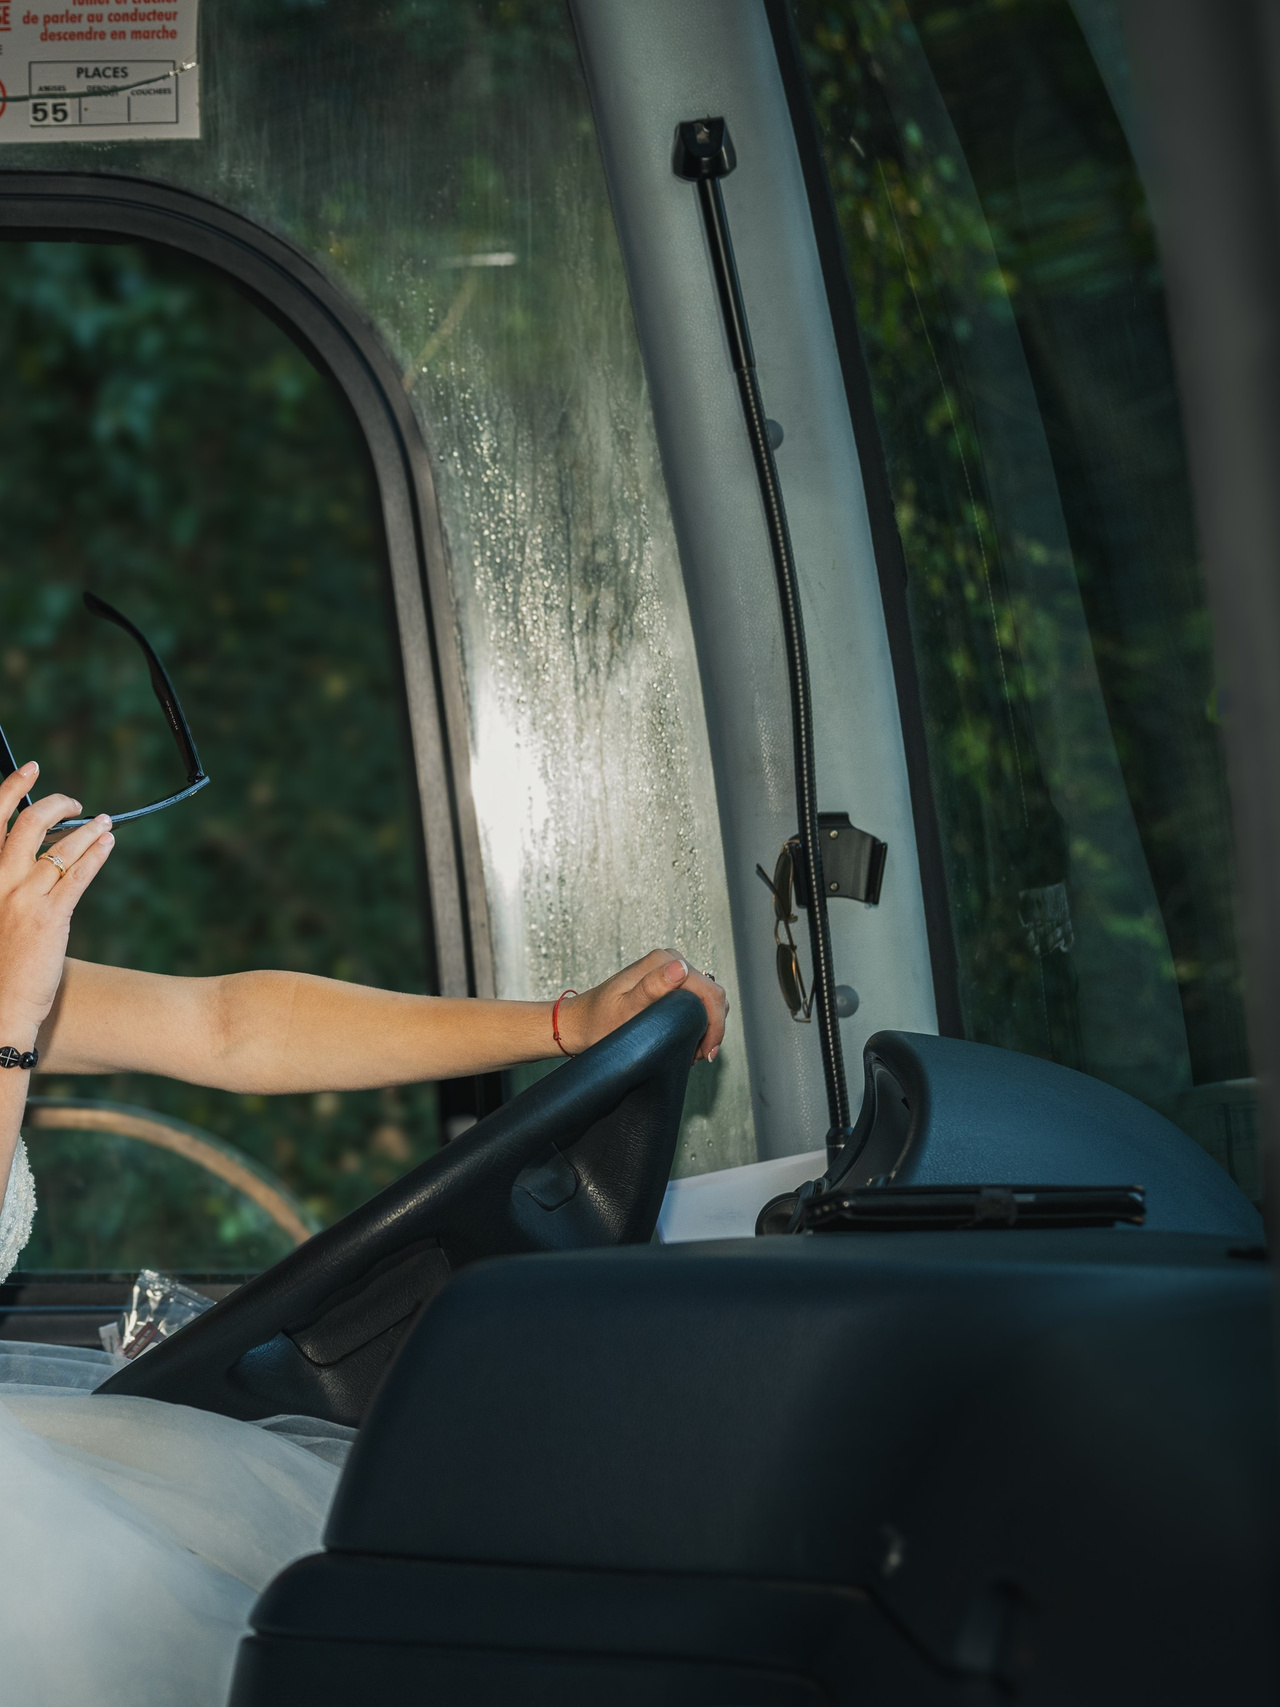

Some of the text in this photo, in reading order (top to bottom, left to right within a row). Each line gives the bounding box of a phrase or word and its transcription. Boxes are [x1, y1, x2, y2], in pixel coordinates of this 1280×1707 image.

[22, 8, 178, 28] de parler au conducteur
[40, 25, 178, 42] descendre en marche
[76, 66, 129, 79] PLACES
[31, 102, 68, 122] 55
